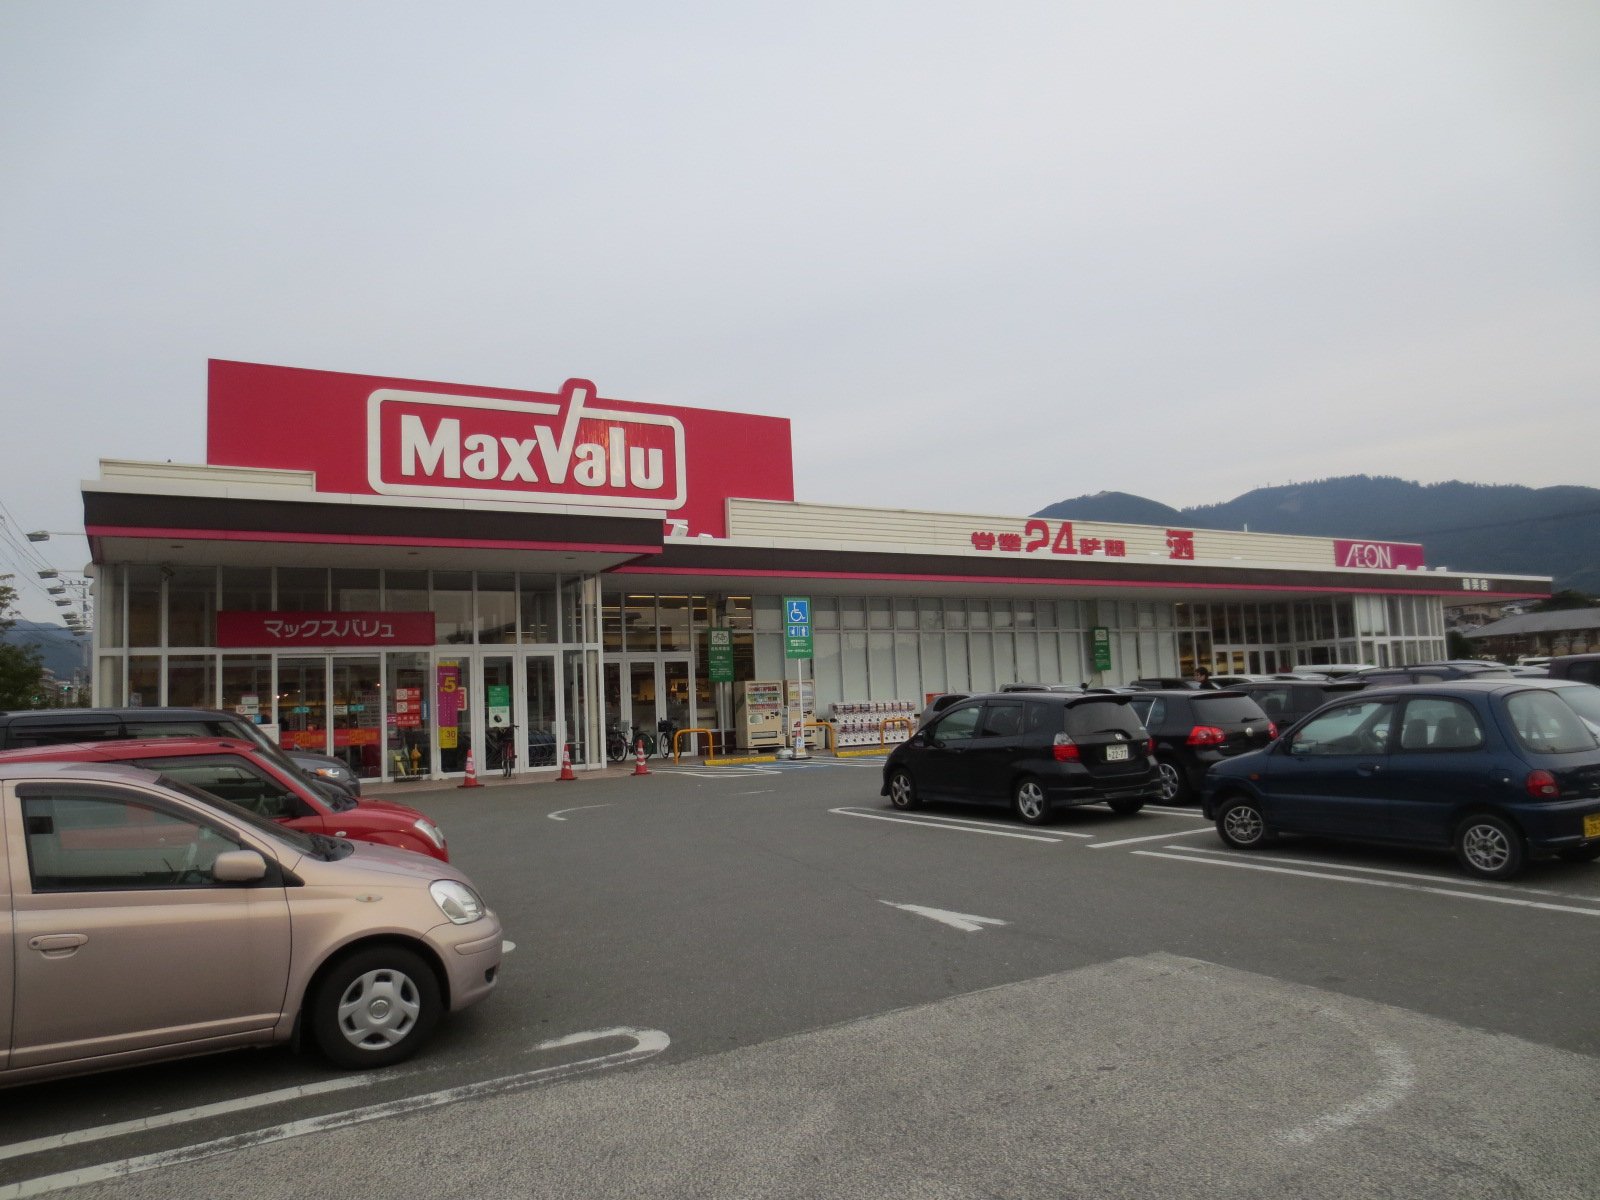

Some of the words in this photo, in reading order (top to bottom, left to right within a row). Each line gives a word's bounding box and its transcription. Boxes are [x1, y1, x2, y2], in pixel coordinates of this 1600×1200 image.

[400, 388, 664, 490] MaxValu
[1166, 528, 1195, 560] 酒
[264, 619, 395, 639] マックスバリュ
